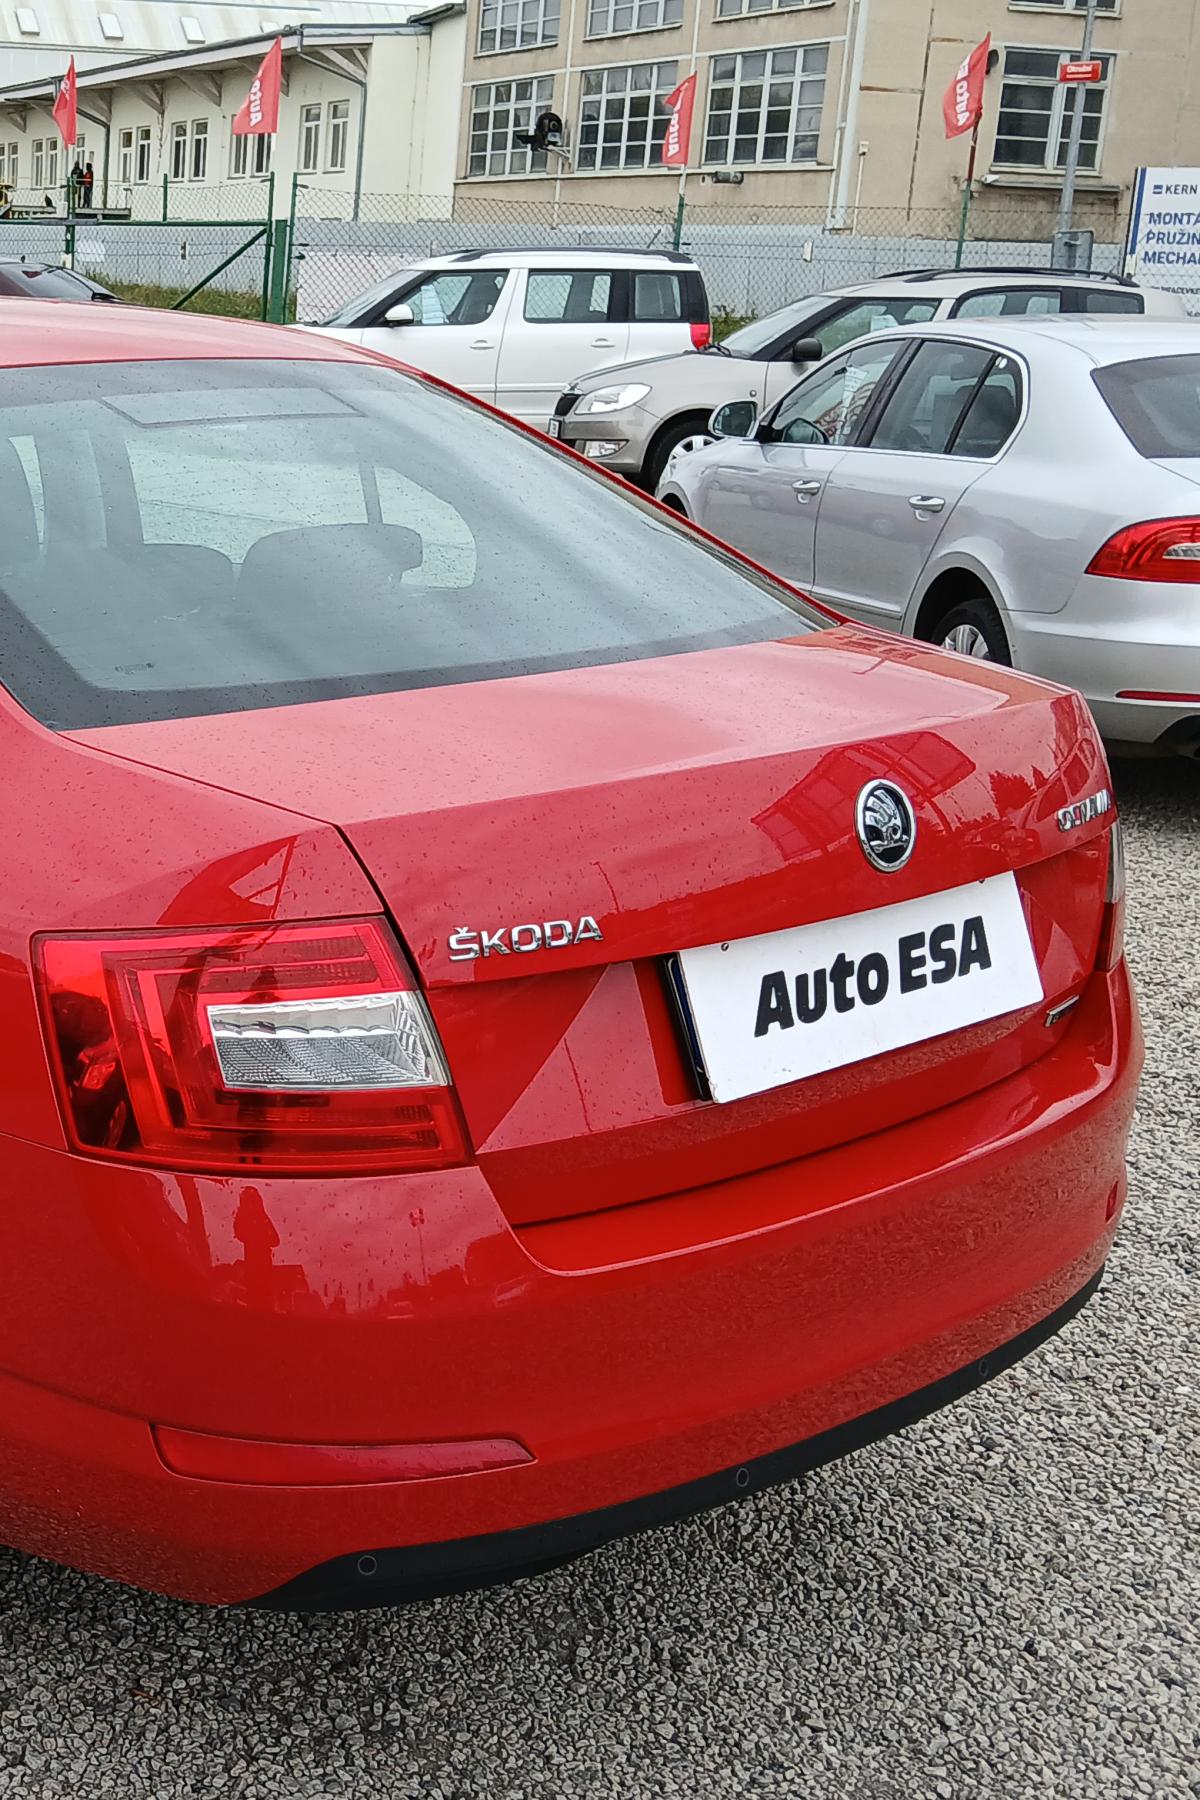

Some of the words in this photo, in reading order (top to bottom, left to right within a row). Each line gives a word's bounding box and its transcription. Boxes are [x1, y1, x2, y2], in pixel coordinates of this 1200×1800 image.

[1165, 184, 1198, 195] KERN
[1143, 251, 1200, 265] MECHA
[449, 916, 604, 961] ŠKODA
[754, 952, 889, 1038] Auto
[898, 915, 992, 995] ESA
